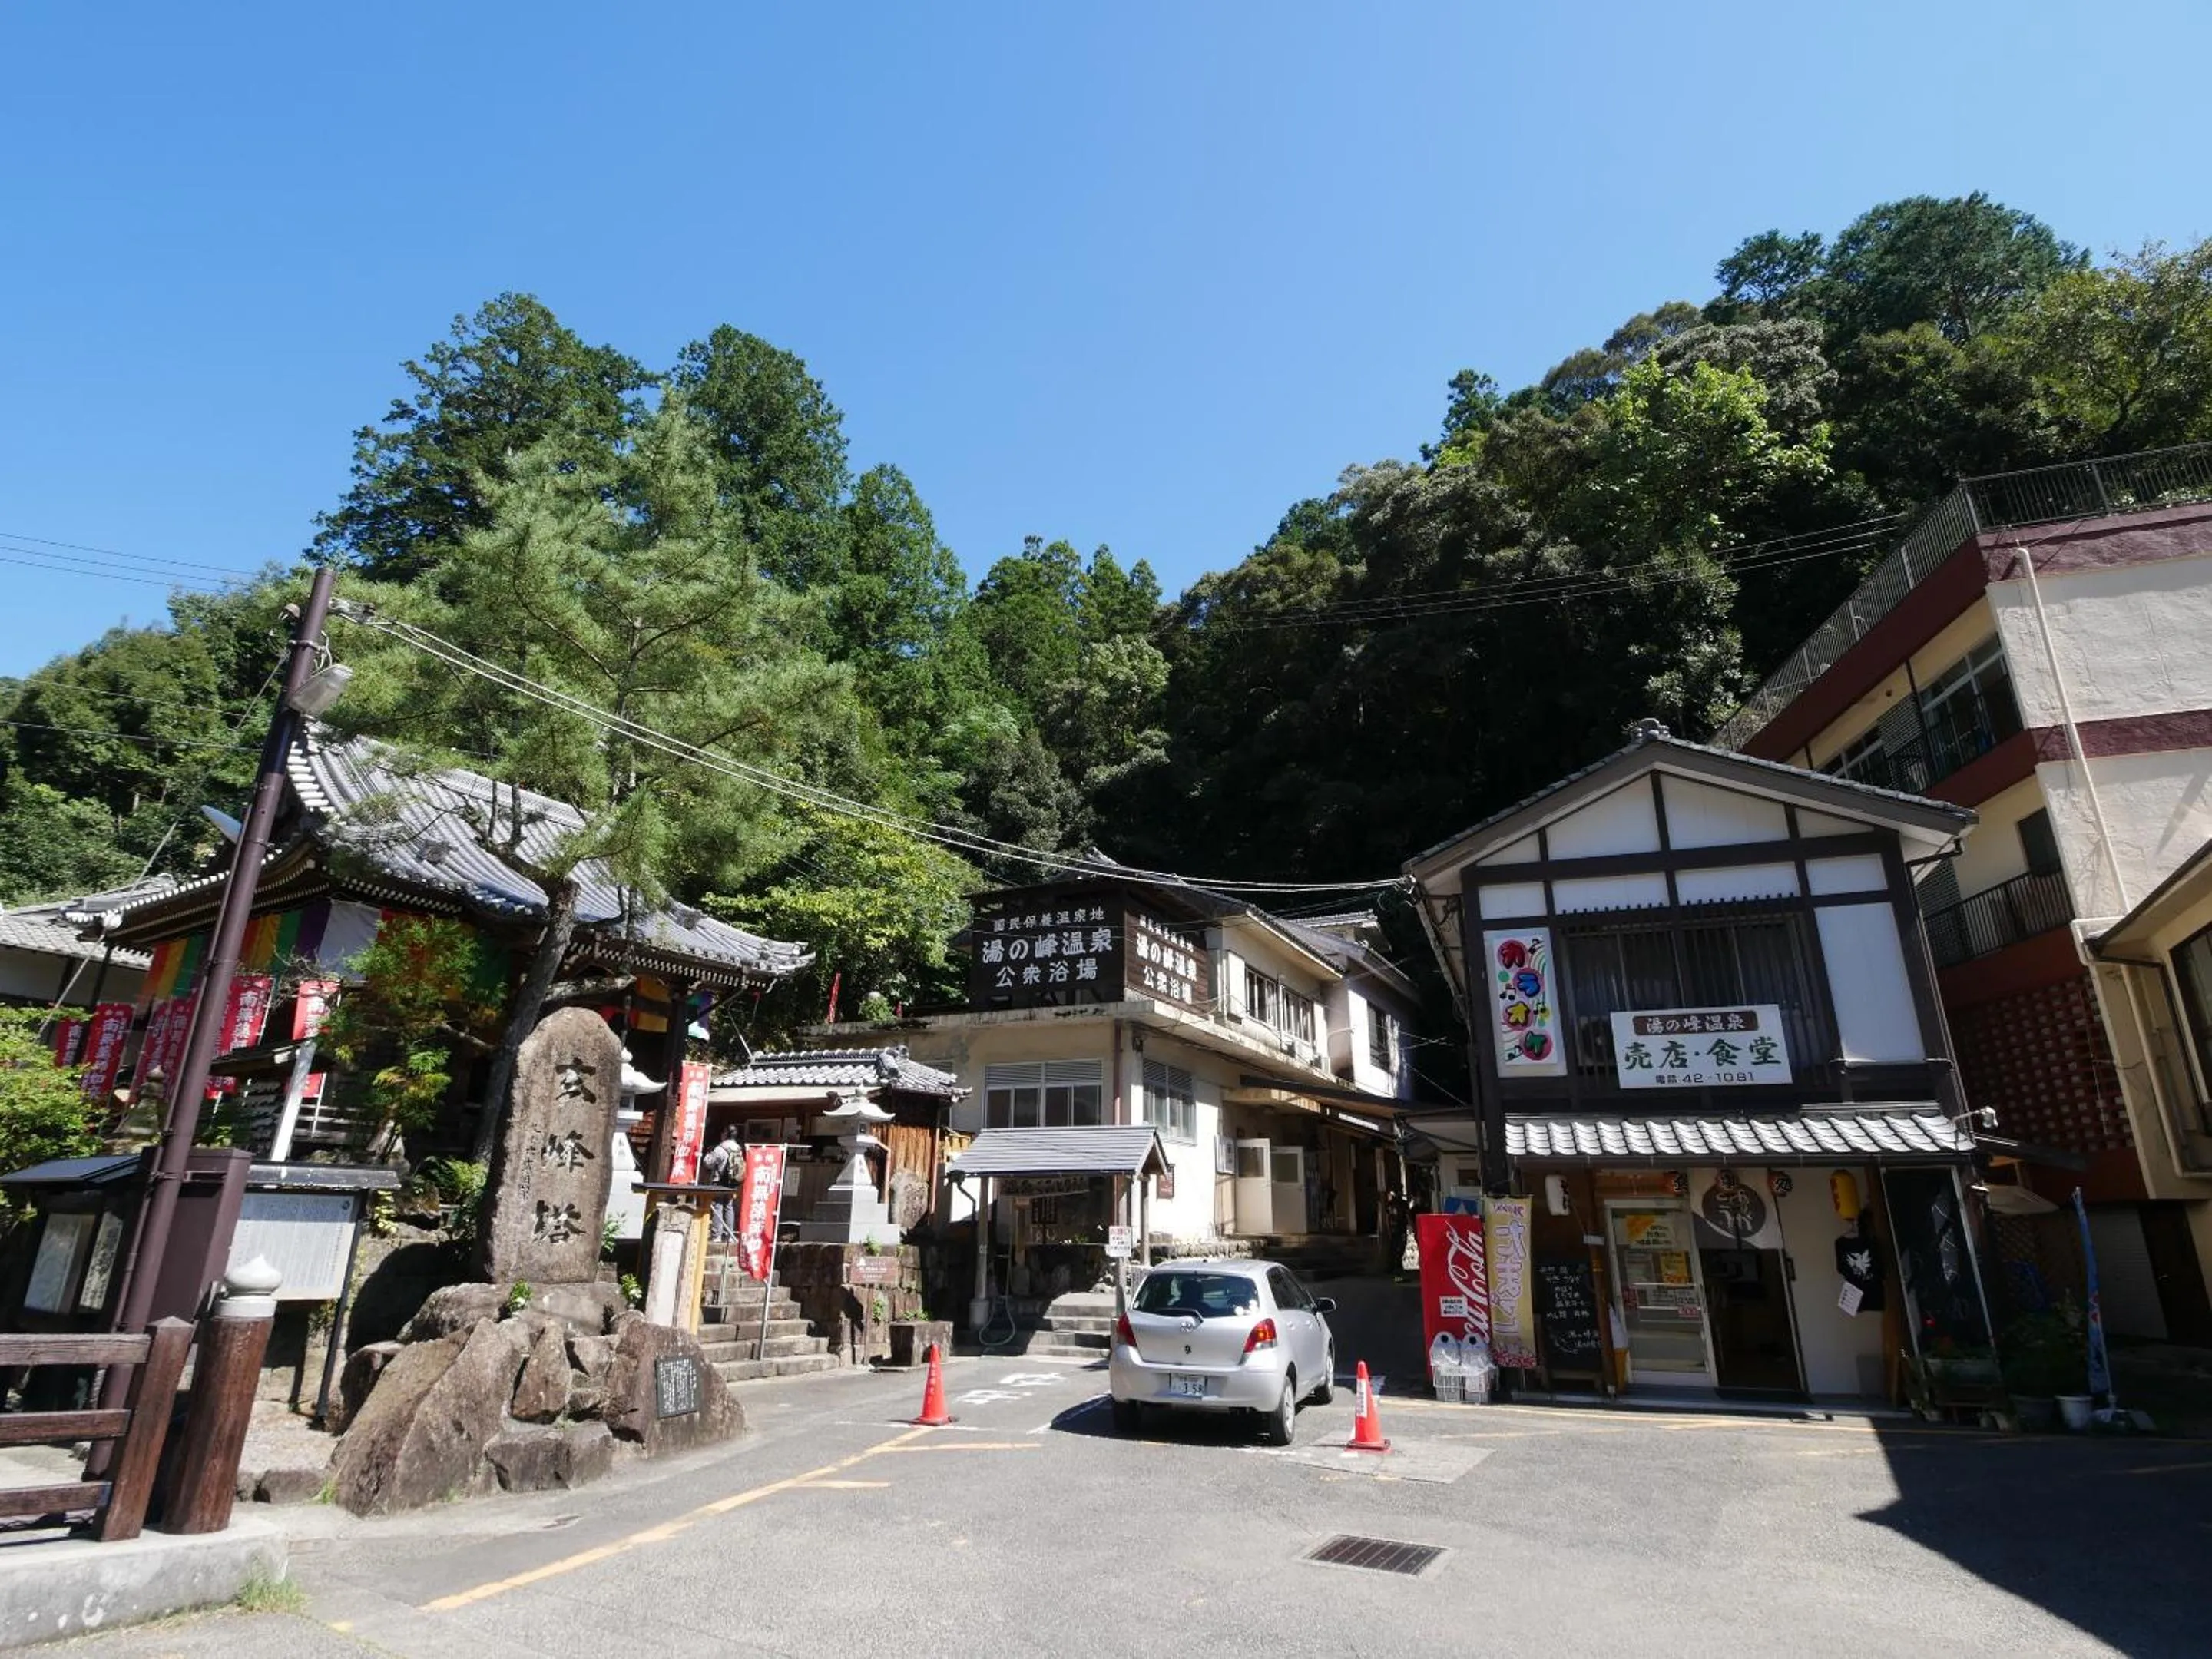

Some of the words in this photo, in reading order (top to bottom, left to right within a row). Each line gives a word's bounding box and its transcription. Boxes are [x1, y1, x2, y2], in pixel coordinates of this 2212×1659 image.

[982, 928, 1113, 963] 湯の峰温泉
[995, 959, 1098, 987] 公衆浴場
[1647, 1013, 1745, 1033] 湯の峰温泉
[1624, 1036, 1781, 1070] 売店・食堂
